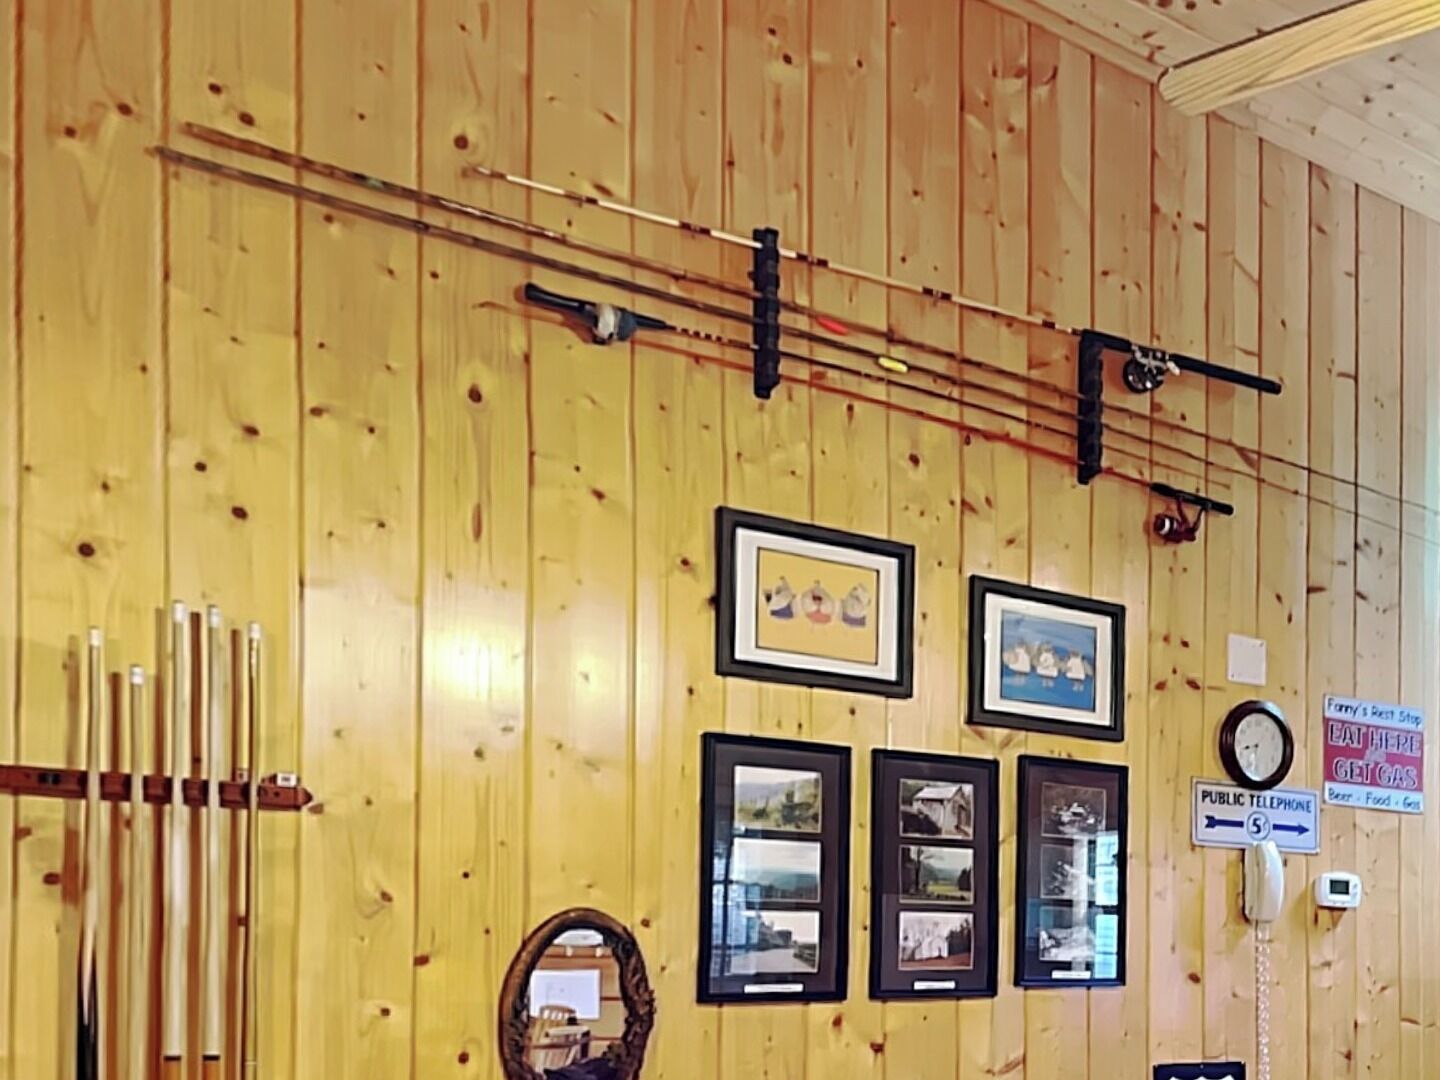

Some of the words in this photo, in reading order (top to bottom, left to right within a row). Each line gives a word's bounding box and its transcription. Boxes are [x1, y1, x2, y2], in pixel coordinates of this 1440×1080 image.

[1371, 705, 1394, 720] Rest
[1399, 710, 1422, 727] Stop
[1329, 721, 1366, 747] EAT
[1369, 728, 1421, 756] HERE
[1334, 757, 1374, 783] GET
[1377, 763, 1417, 788] GAS
[1201, 790, 1245, 806] PUBLIC
[1249, 794, 1312, 813] TELEPHONE
[1366, 791, 1391, 806] Food
[1402, 796, 1420, 810] Gas
